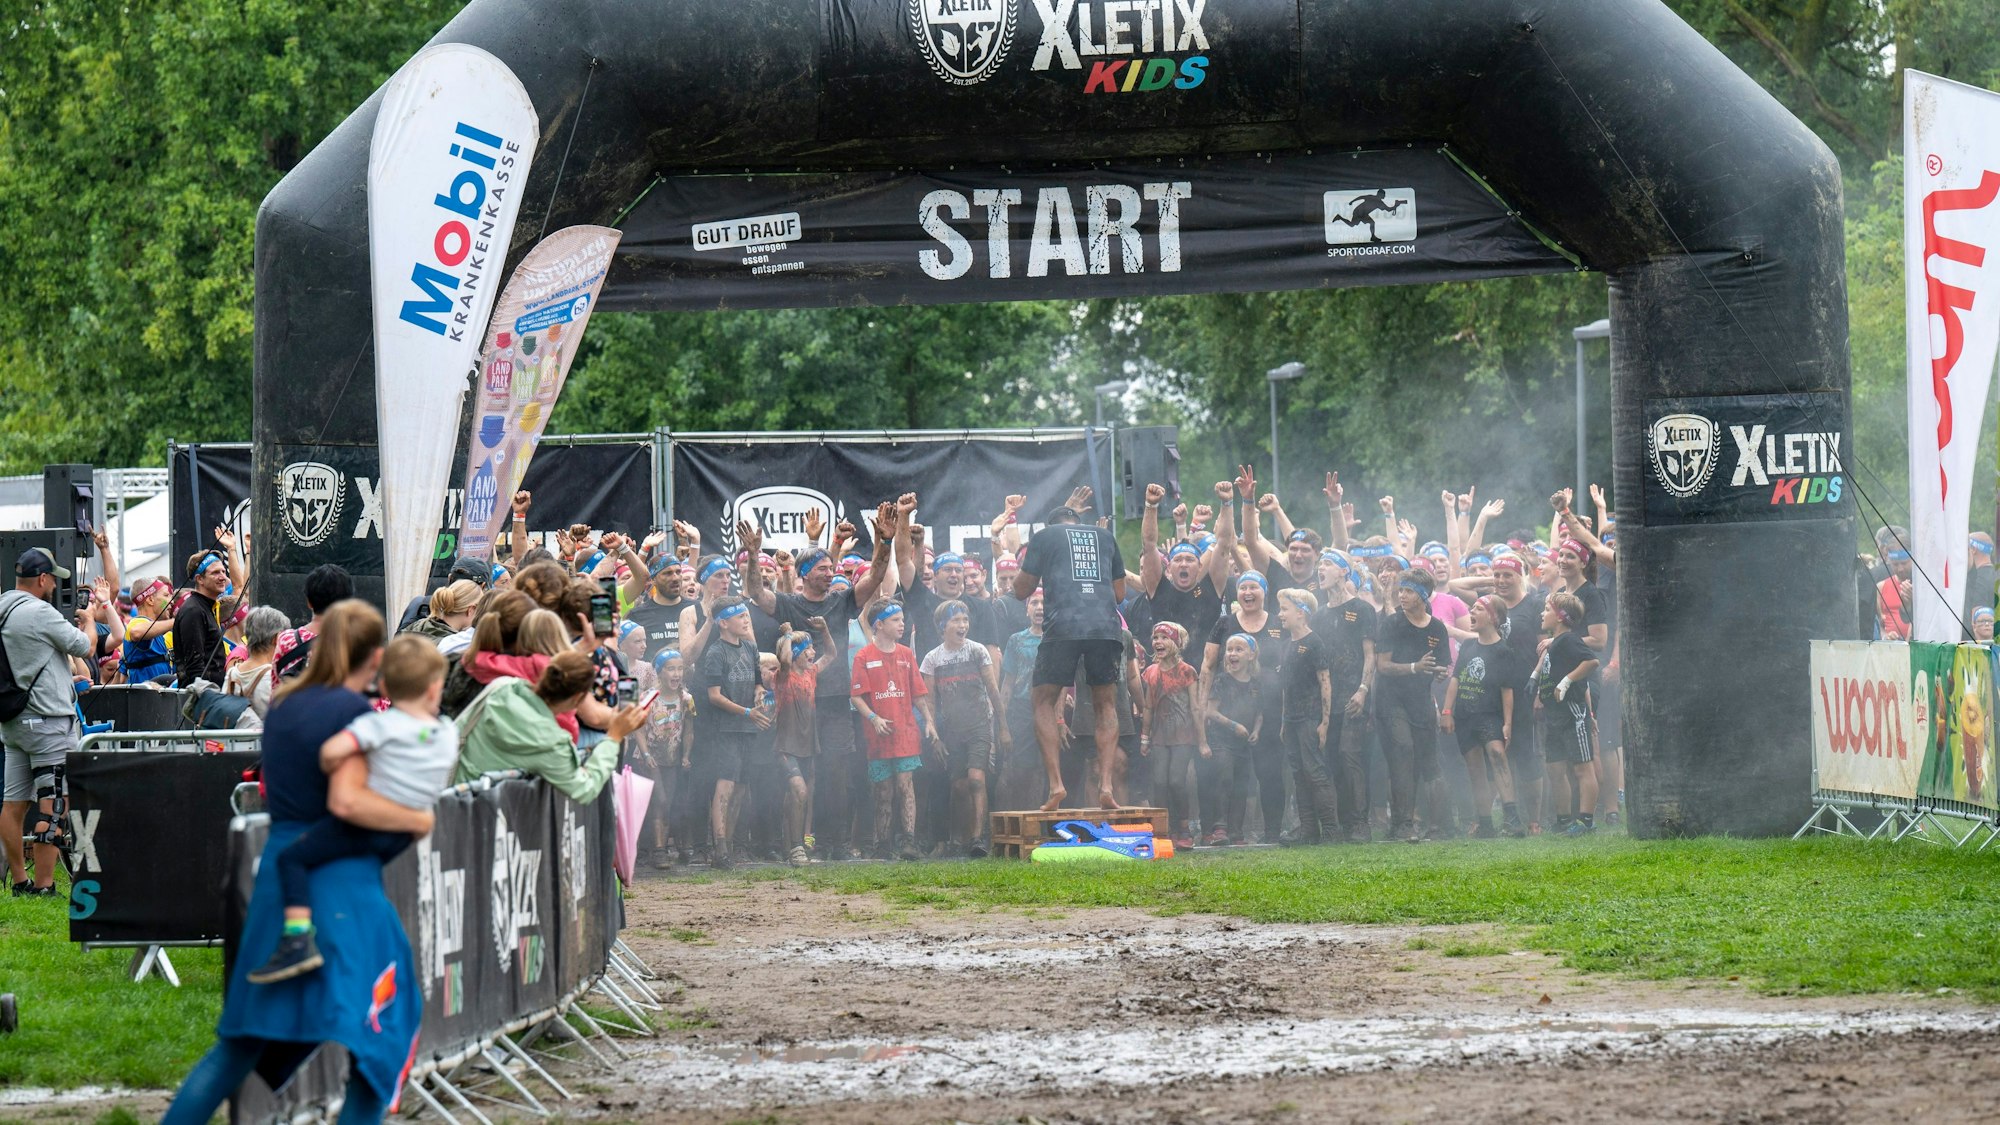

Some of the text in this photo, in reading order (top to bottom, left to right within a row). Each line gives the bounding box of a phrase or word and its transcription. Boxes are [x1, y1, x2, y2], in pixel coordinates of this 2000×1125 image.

[1031, 0, 1211, 71] XLETIX
[954, 77, 979, 86] EST.2013
[1083, 56, 1210, 94] KIDS
[399, 121, 503, 336] Mobil
[697, 219, 796, 245] GUT DRAUF
[919, 181, 1192, 280] START
[449, 141, 520, 342] KRANKENKASSE
[746, 242, 787, 254] bewegen
[1327, 245, 1415, 257] SPORTOGRAF.COM
[742, 255, 769, 265] essen
[752, 261, 805, 275] entspannen
[491, 361, 511, 375] LAND
[491, 374, 509, 388] PARK
[1664, 426, 1702, 445] XLETIX
[1729, 424, 1843, 486] XLETIX
[292, 473, 327, 493] XLETIX
[468, 475, 497, 499] LAND
[1770, 476, 1843, 505] KIDS
[466, 498, 494, 522] PARK
[752, 507, 809, 539] XLETI
[1072, 538, 1095, 546] HREE
[1073, 545, 1096, 553] INTEA
[1074, 553, 1097, 561] MEIN
[1075, 561, 1097, 569] ZIELX
[1075, 569, 1098, 578] LETIX
